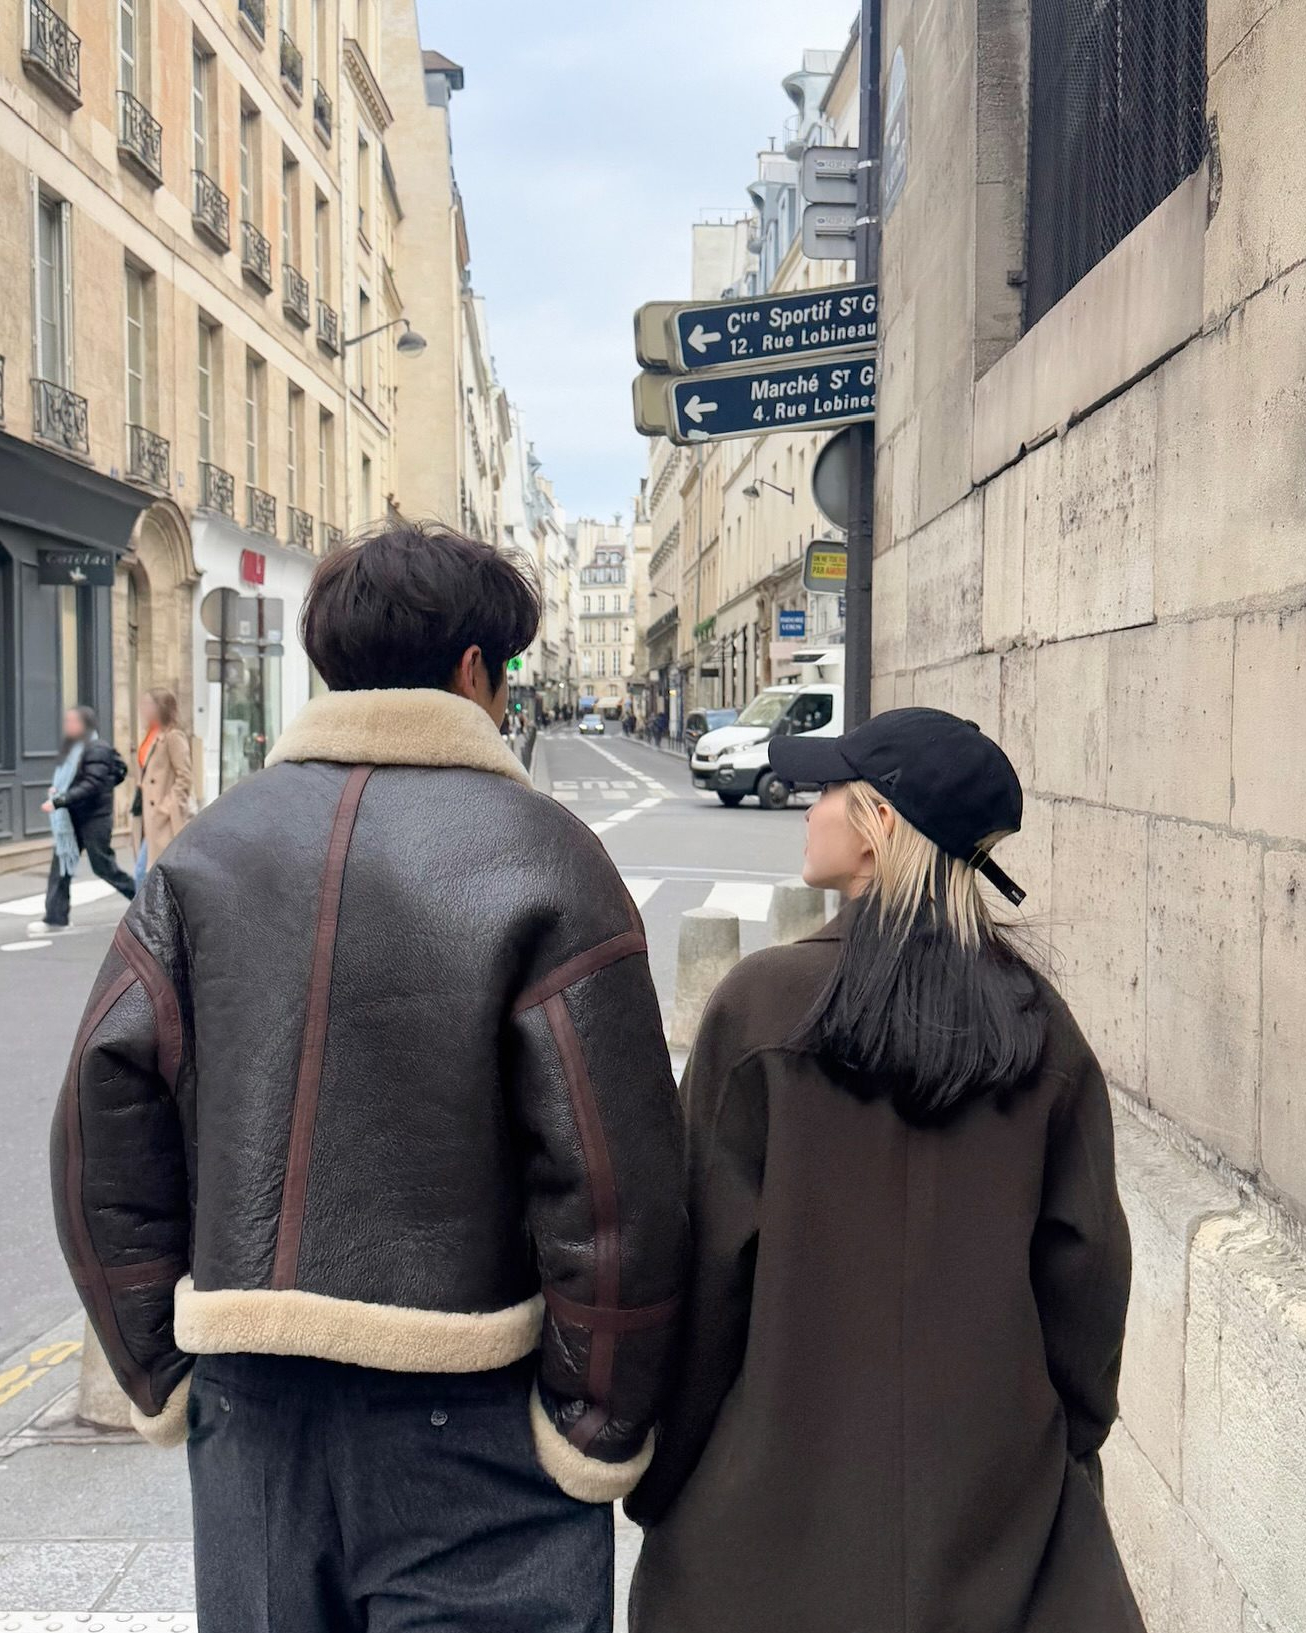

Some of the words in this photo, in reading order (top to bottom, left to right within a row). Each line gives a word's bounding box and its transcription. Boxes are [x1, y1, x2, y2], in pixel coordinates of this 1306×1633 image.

[727, 311, 760, 334] Ctre
[769, 298, 832, 332] Sportif
[762, 334, 794, 351] Rue
[801, 322, 876, 345] Lobineau
[751, 372, 819, 401] Marché
[775, 402, 807, 420] Rue
[814, 393, 876, 413] Lobinea
